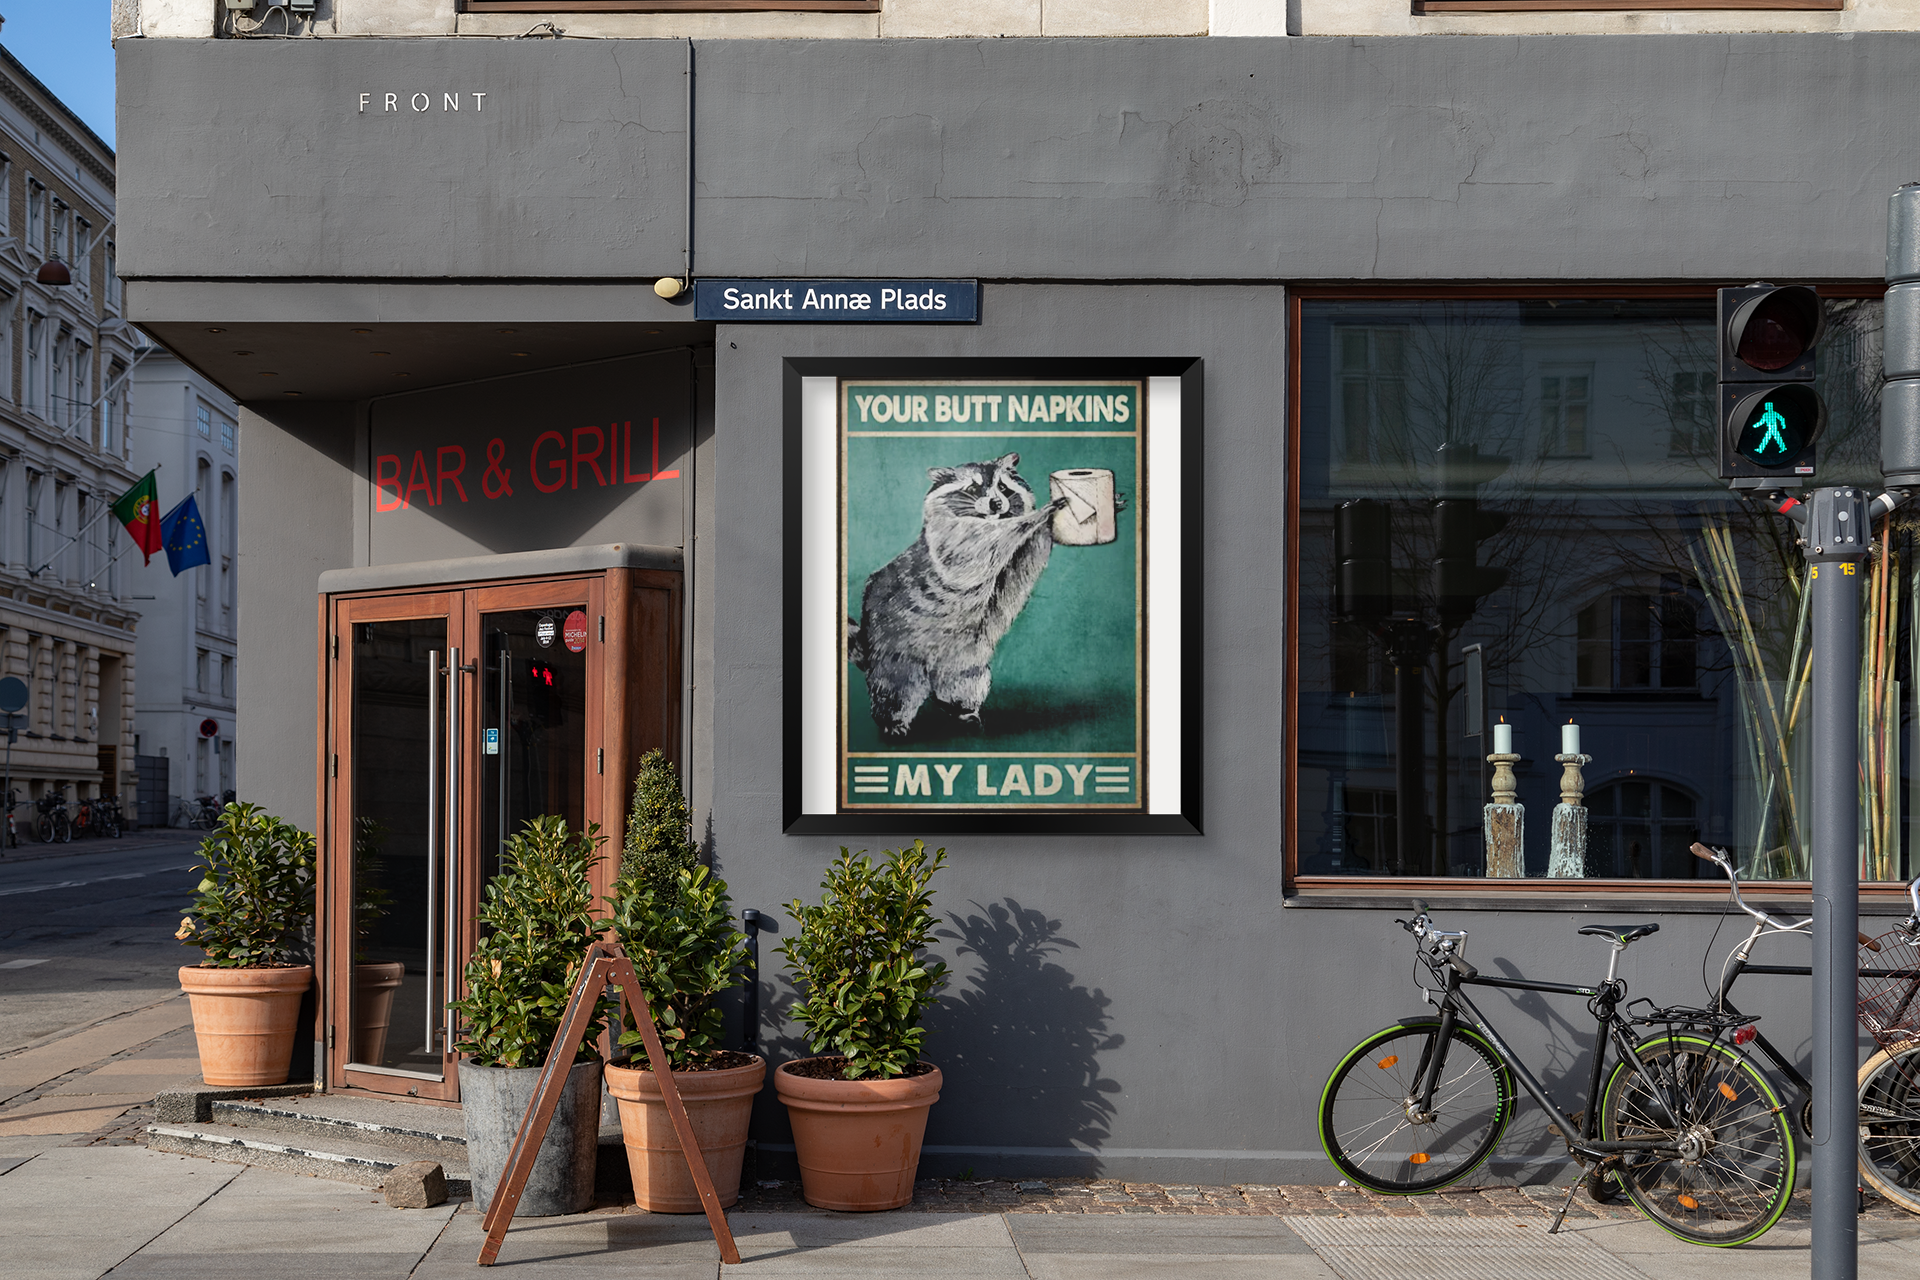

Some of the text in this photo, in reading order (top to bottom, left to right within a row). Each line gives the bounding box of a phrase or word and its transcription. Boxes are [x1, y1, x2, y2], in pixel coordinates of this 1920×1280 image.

[359, 92, 487, 112] FRONT
[723, 288, 947, 310] Sankt Annæ Plads
[854, 394, 1130, 423] YOUR BUTT NAPKINS
[375, 417, 680, 513] BAR & GRILL
[1838, 562, 1856, 576] 15
[894, 764, 1094, 796] MY LADY
